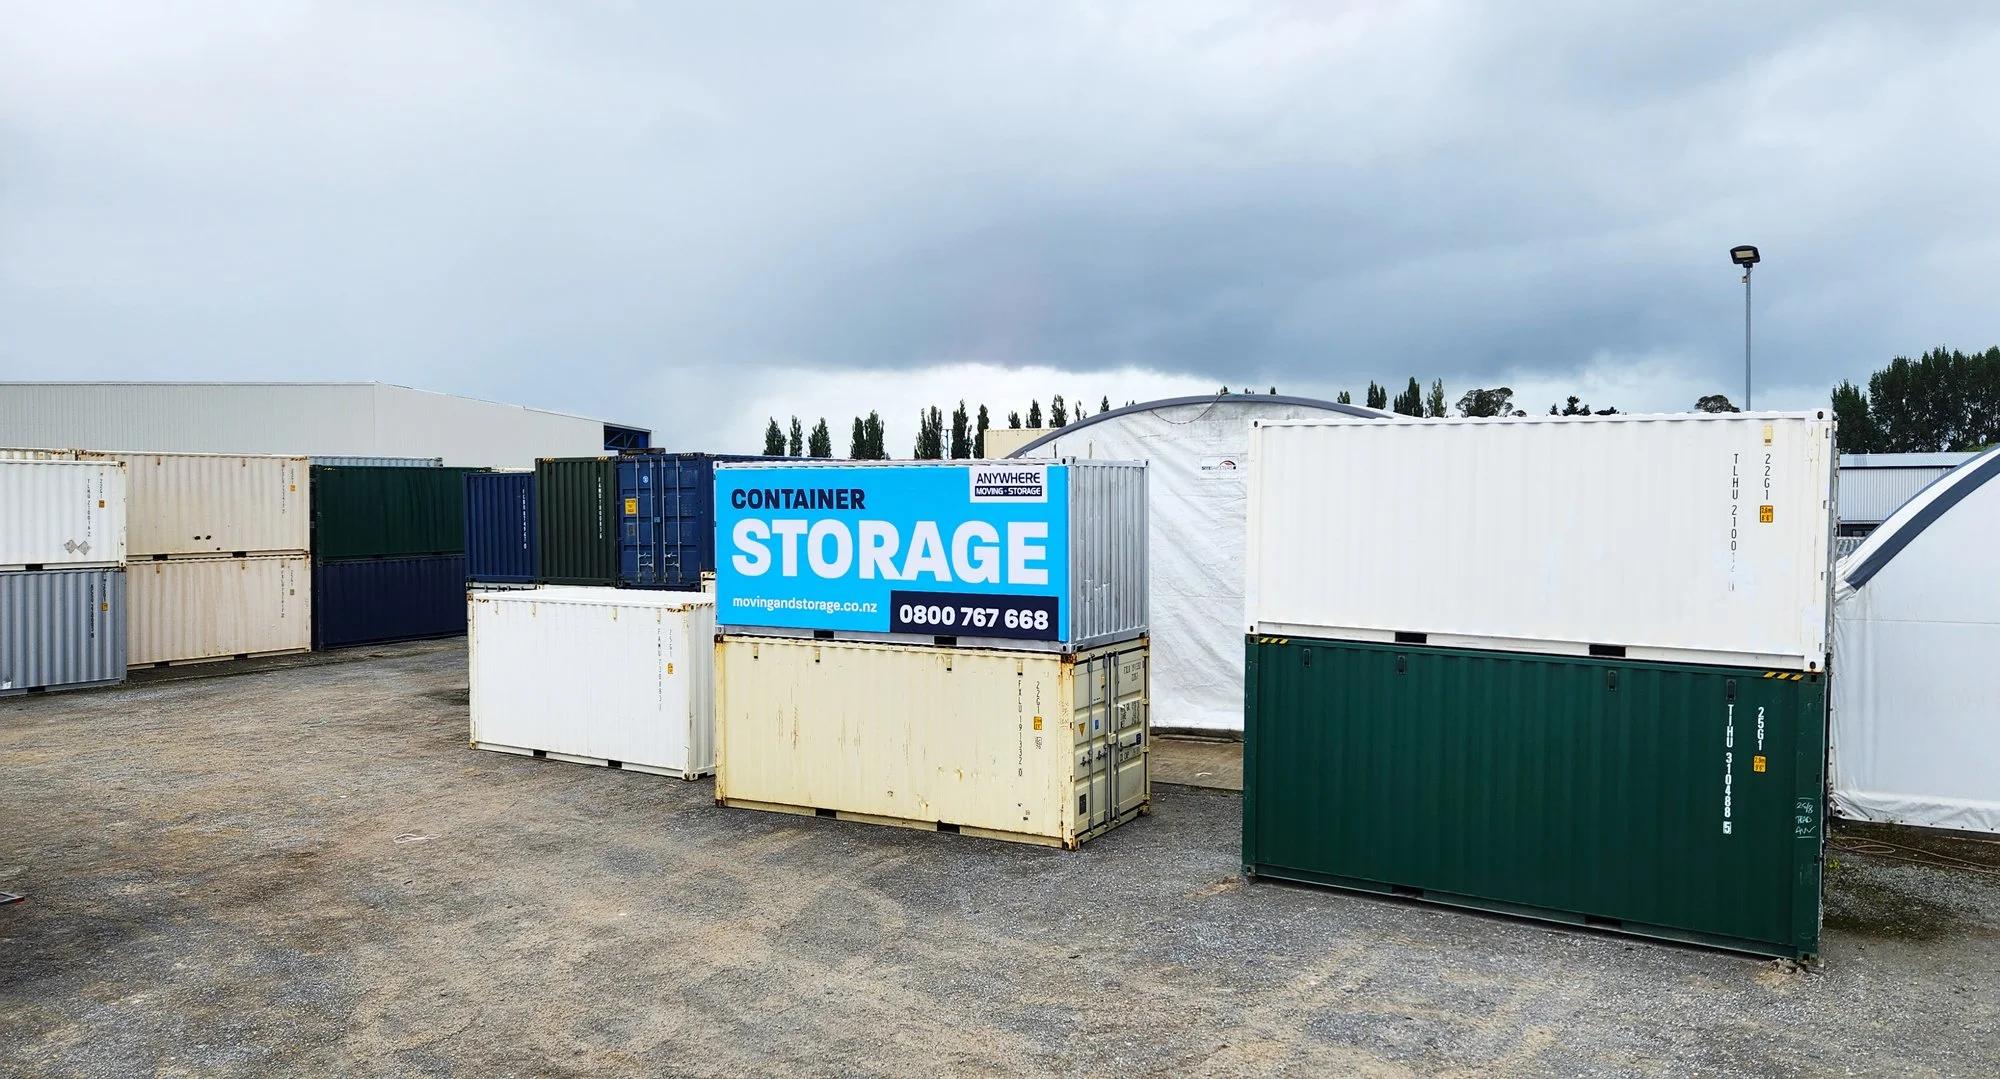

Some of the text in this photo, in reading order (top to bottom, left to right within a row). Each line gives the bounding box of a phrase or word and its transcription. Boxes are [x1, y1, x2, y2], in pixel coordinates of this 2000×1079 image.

[976, 472, 1041, 484] ANYWHERE
[976, 487, 1041, 495] MOVING STORAGE
[1763, 453, 1771, 500] 22G1
[731, 488, 866, 510] CONTAINER
[731, 518, 1049, 585] STORAGE
[732, 595, 878, 614] movingandstorage.co.nz
[899, 604, 1049, 630] 0800 767 668
[1726, 704, 1734, 748] TIHU
[1757, 706, 1765, 751] 25G1
[1724, 752, 1733, 818] 310488
